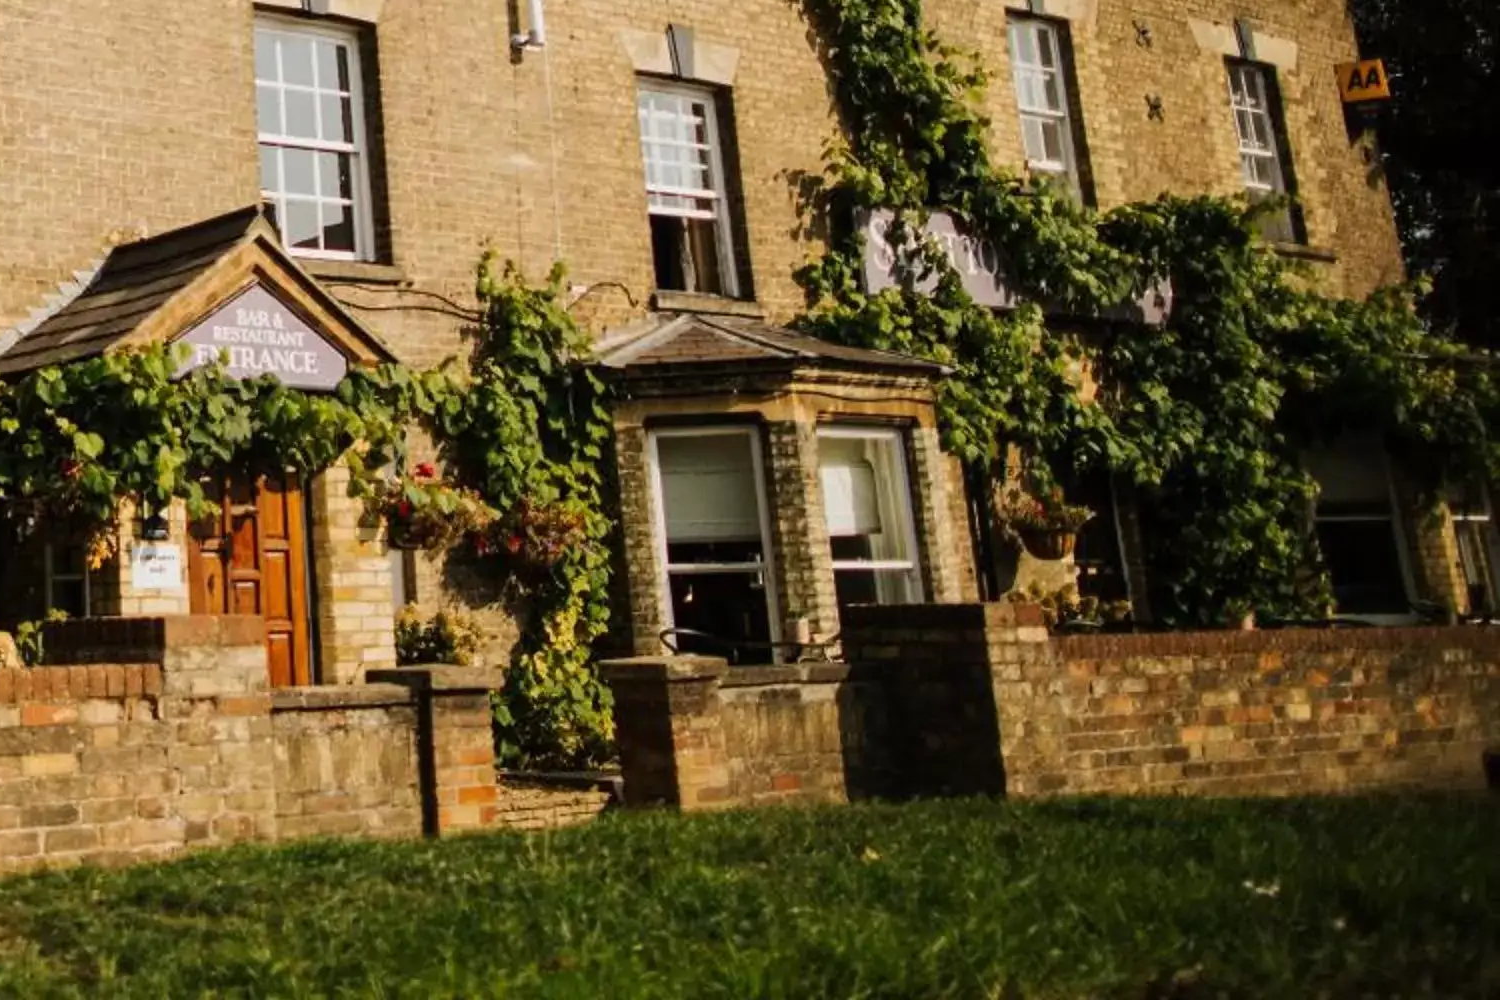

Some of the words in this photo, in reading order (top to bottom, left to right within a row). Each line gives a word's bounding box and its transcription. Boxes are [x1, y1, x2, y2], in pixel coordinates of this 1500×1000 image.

[1348, 66, 1381, 91] AA
[235, 308, 271, 326] BAR
[273, 312, 284, 329] &
[213, 326, 305, 347] RESTAURANT
